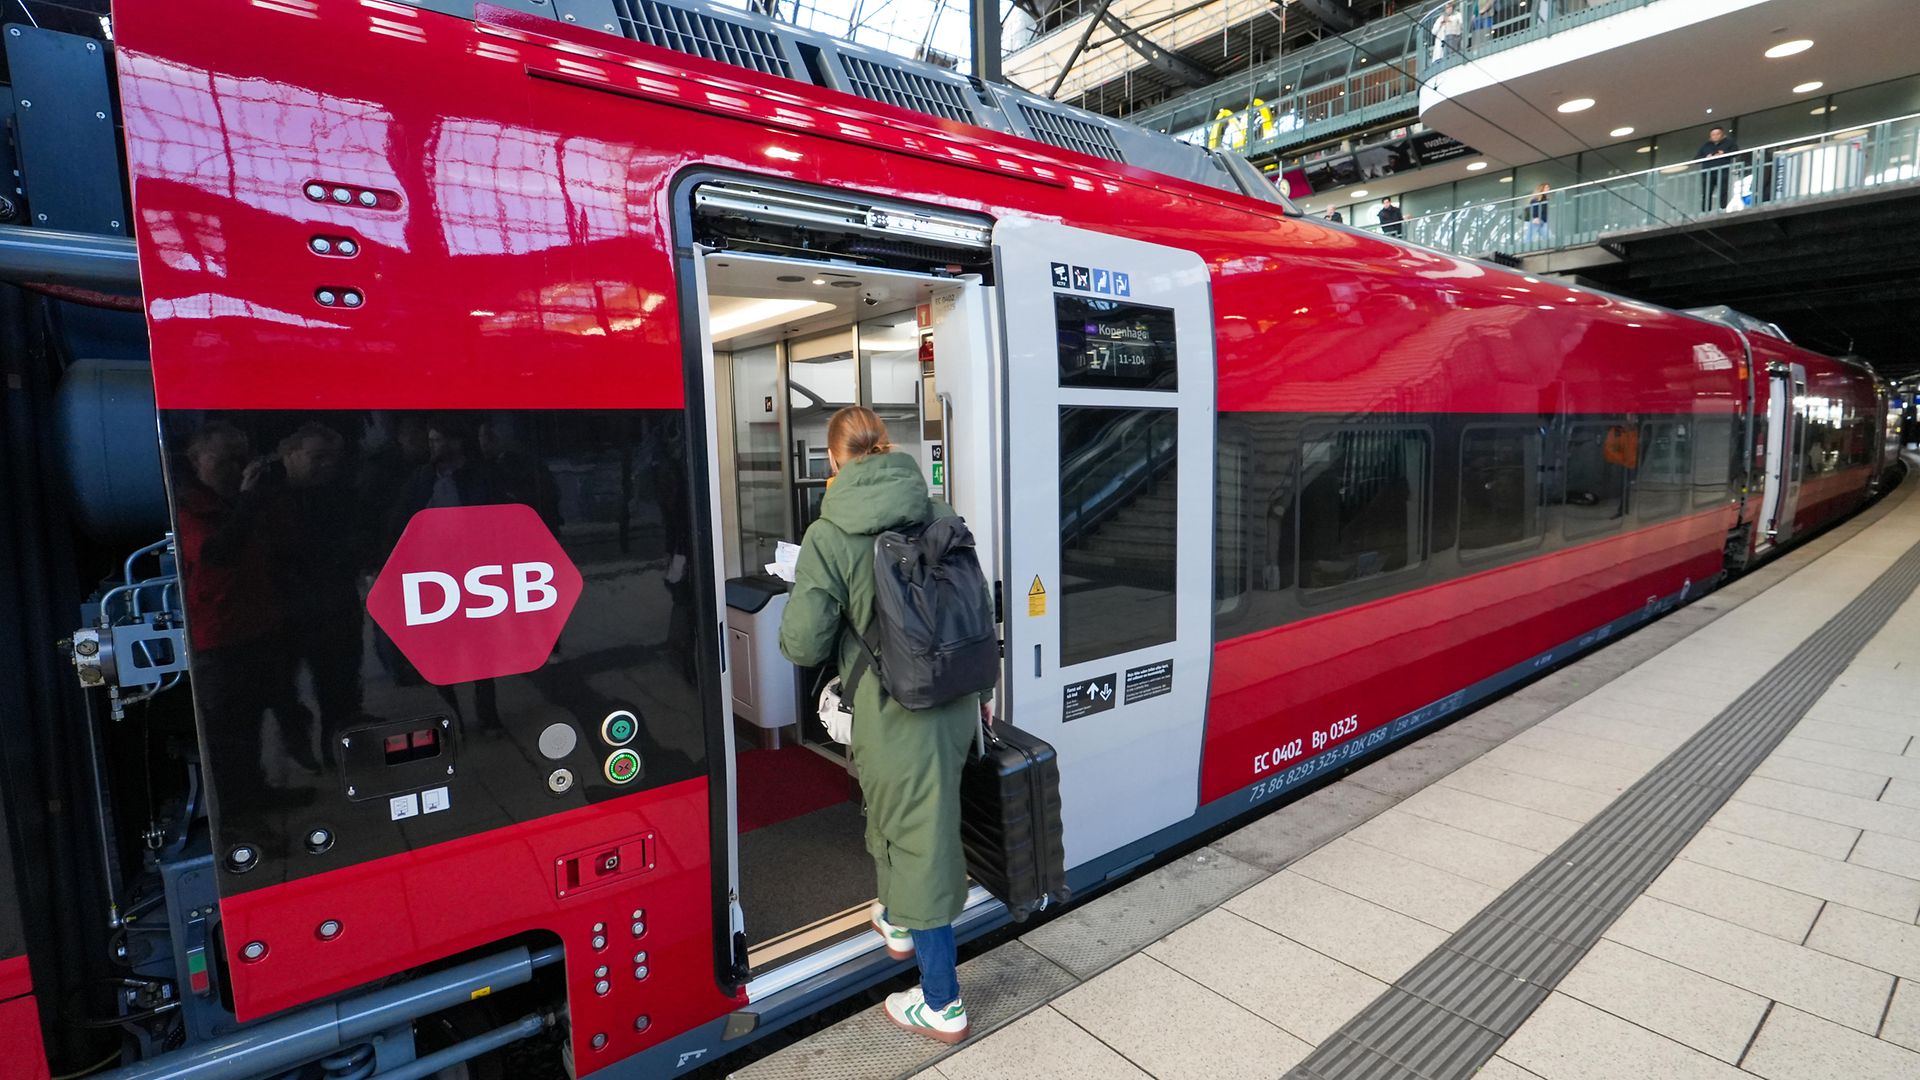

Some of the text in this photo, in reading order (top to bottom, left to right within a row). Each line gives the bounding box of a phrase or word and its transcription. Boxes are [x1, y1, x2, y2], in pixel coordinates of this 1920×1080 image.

[1086, 349, 1110, 370] 17
[1119, 354, 1146, 365] 11-104
[402, 562, 558, 626] DSB
[1249, 727, 1388, 802] 73 86 8293 325-9 DK DSB
[1254, 714, 1358, 774] EC 0402 Bp 0325
